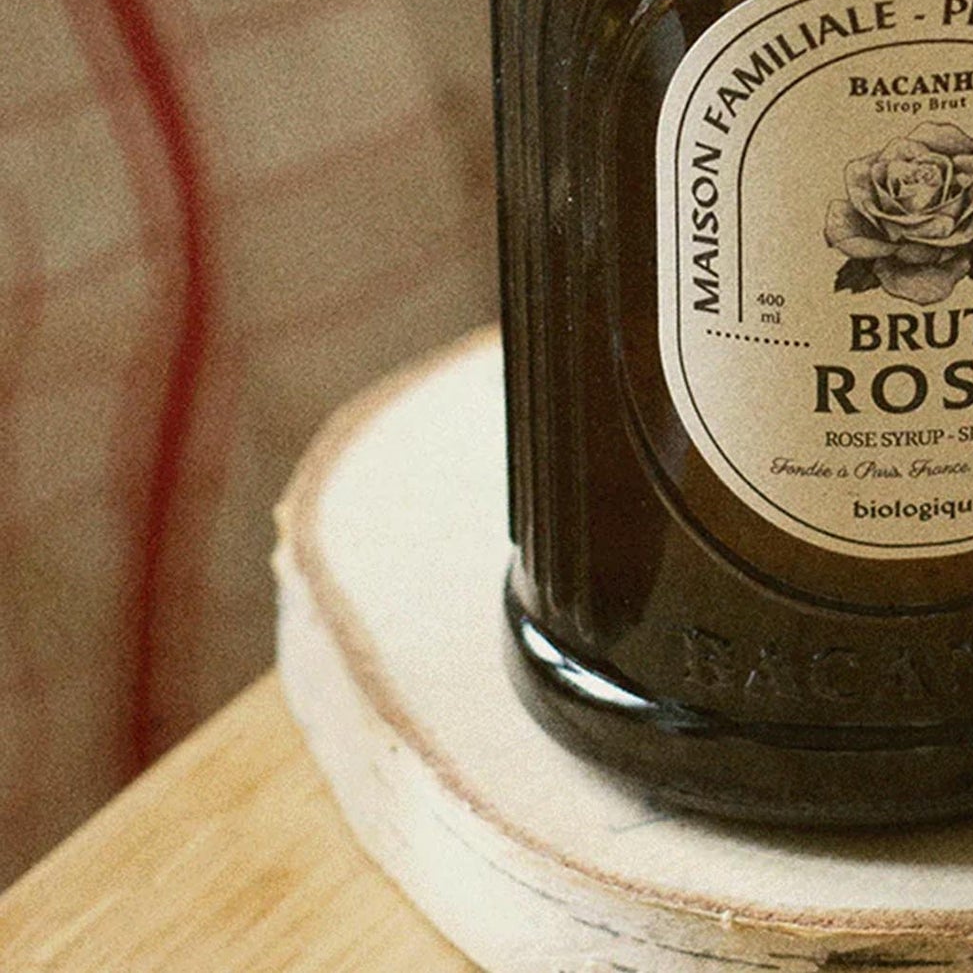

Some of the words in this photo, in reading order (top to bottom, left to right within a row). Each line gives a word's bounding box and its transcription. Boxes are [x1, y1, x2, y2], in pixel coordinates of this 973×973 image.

[704, 0, 898, 135] FAMILIALE
[875, 99, 922, 115] Sirop
[929, 96, 967, 111] Brut
[693, 141, 722, 314] MAISON
[756, 293, 786, 308] 400
[825, 431, 878, 448] ROSE
[881, 429, 945, 448] SYRUP
